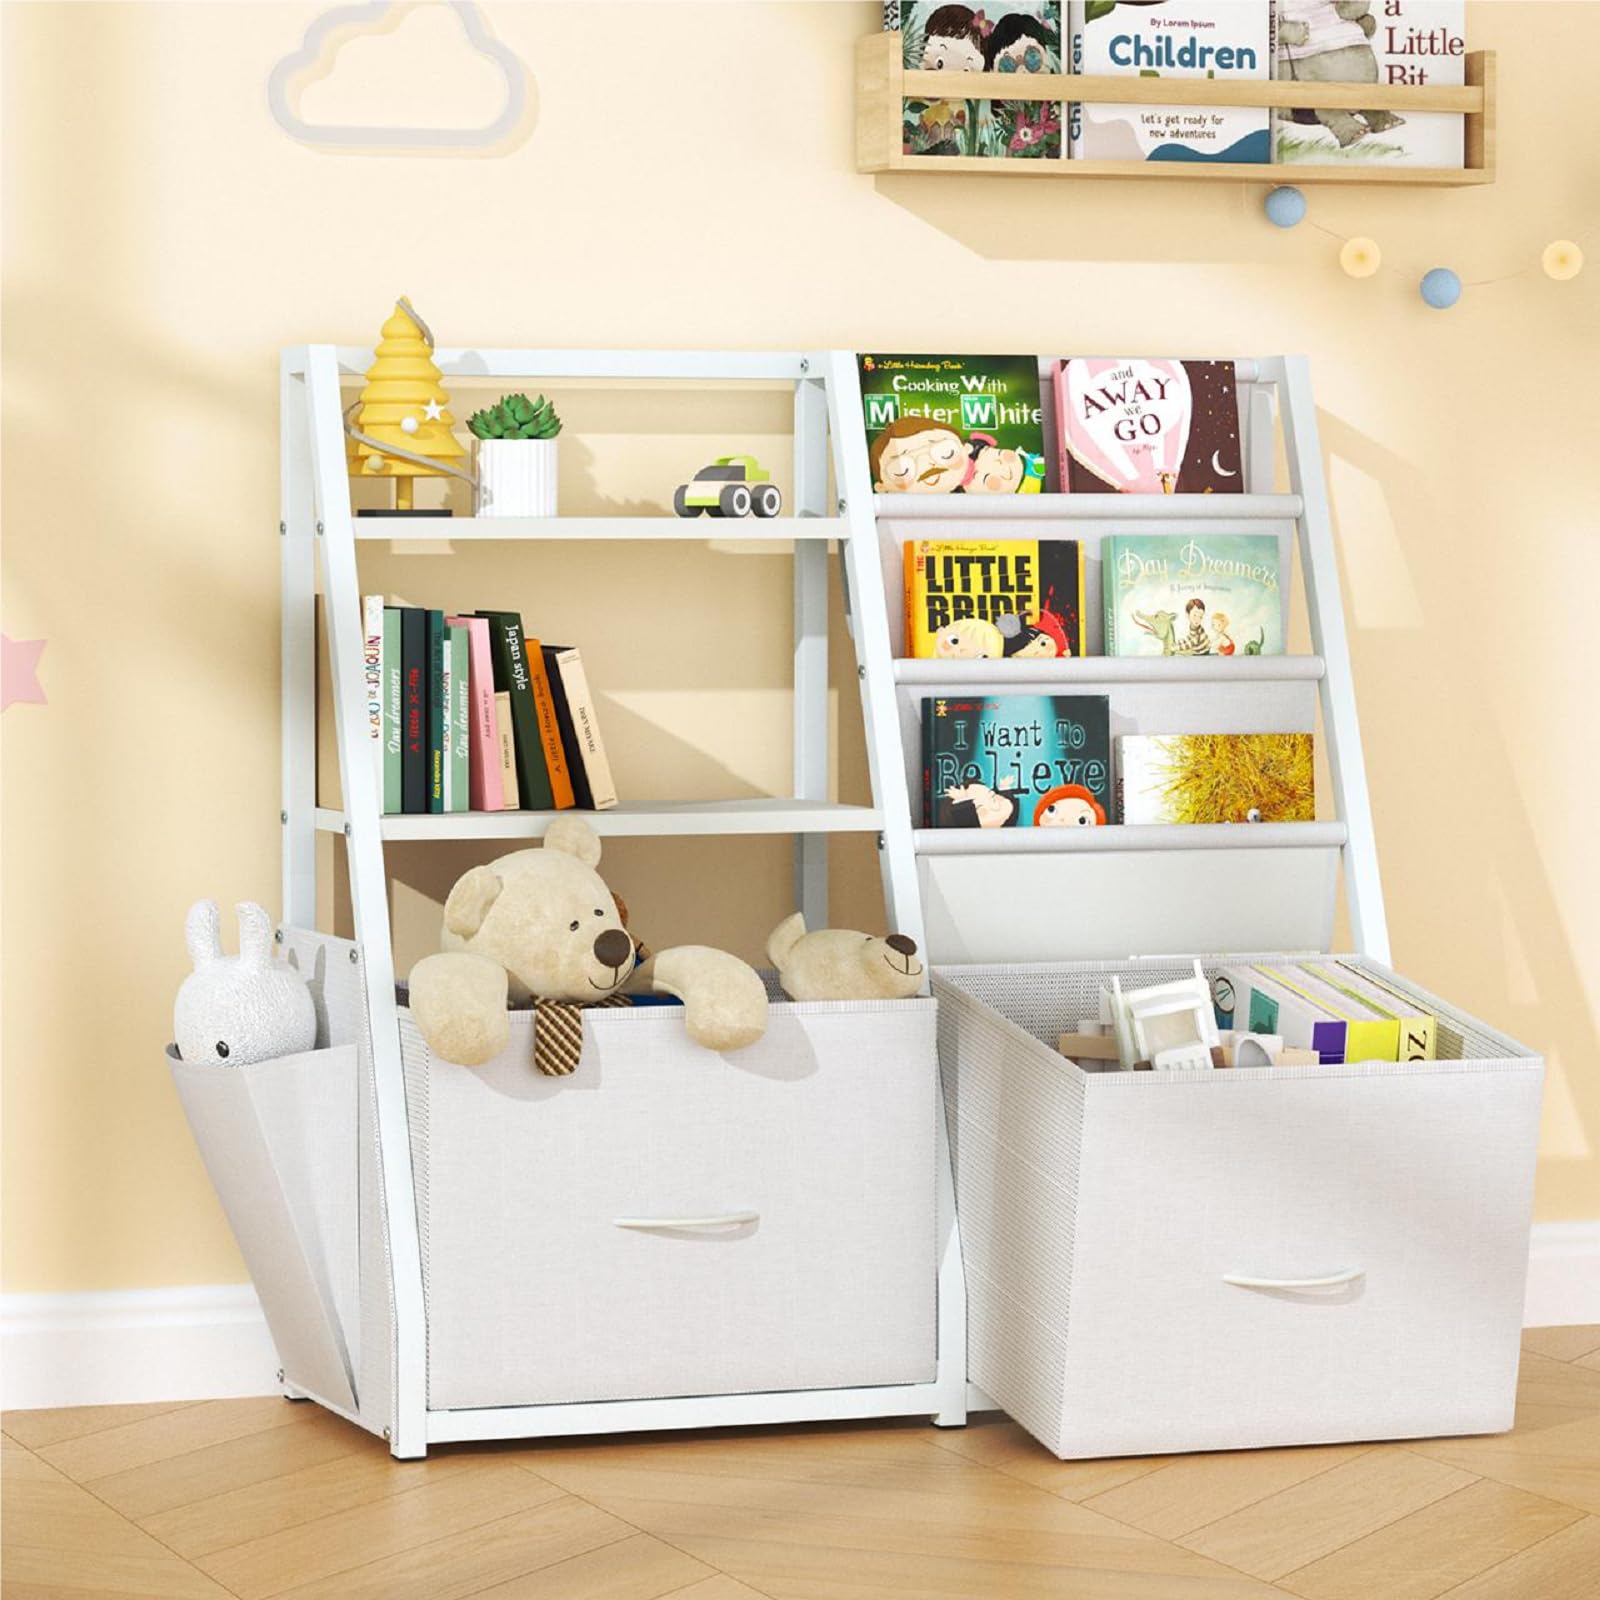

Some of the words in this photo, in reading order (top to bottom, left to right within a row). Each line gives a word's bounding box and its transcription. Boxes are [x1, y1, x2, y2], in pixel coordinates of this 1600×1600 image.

[1384, 0, 1402, 17] a
[1150, 18, 1161, 29] By
[1163, 19, 1189, 28] Lorem
[1190, 20, 1215, 30] Ipsum
[1108, 34, 1256, 69] Children
[1384, 27, 1465, 56] Little
[1384, 64, 1428, 85] Bit
[1149, 130, 1166, 138] new
[1170, 129, 1216, 139] adventures
[1165, 115, 1180, 127] get
[1183, 115, 1208, 128] ready
[1211, 115, 1225, 125] for
[892, 375, 960, 395] Cooking
[960, 375, 1008, 394] With
[1110, 365, 1134, 382] and
[1082, 377, 1171, 420] AWAY
[1123, 403, 1143, 417] we
[1113, 413, 1161, 441] GO
[925, 555, 1033, 593] LITTLE
[1117, 547, 1169, 588] Day
[1178, 539, 1278, 592] Dreamers
[505, 624, 522, 660] Japan
[512, 662, 527, 691] style
[385, 668, 401, 724] dreamers
[953, 719, 968, 750] I
[980, 719, 1043, 748] Want
[1055, 719, 1086, 749] To
[935, 750, 1106, 798] Believe
